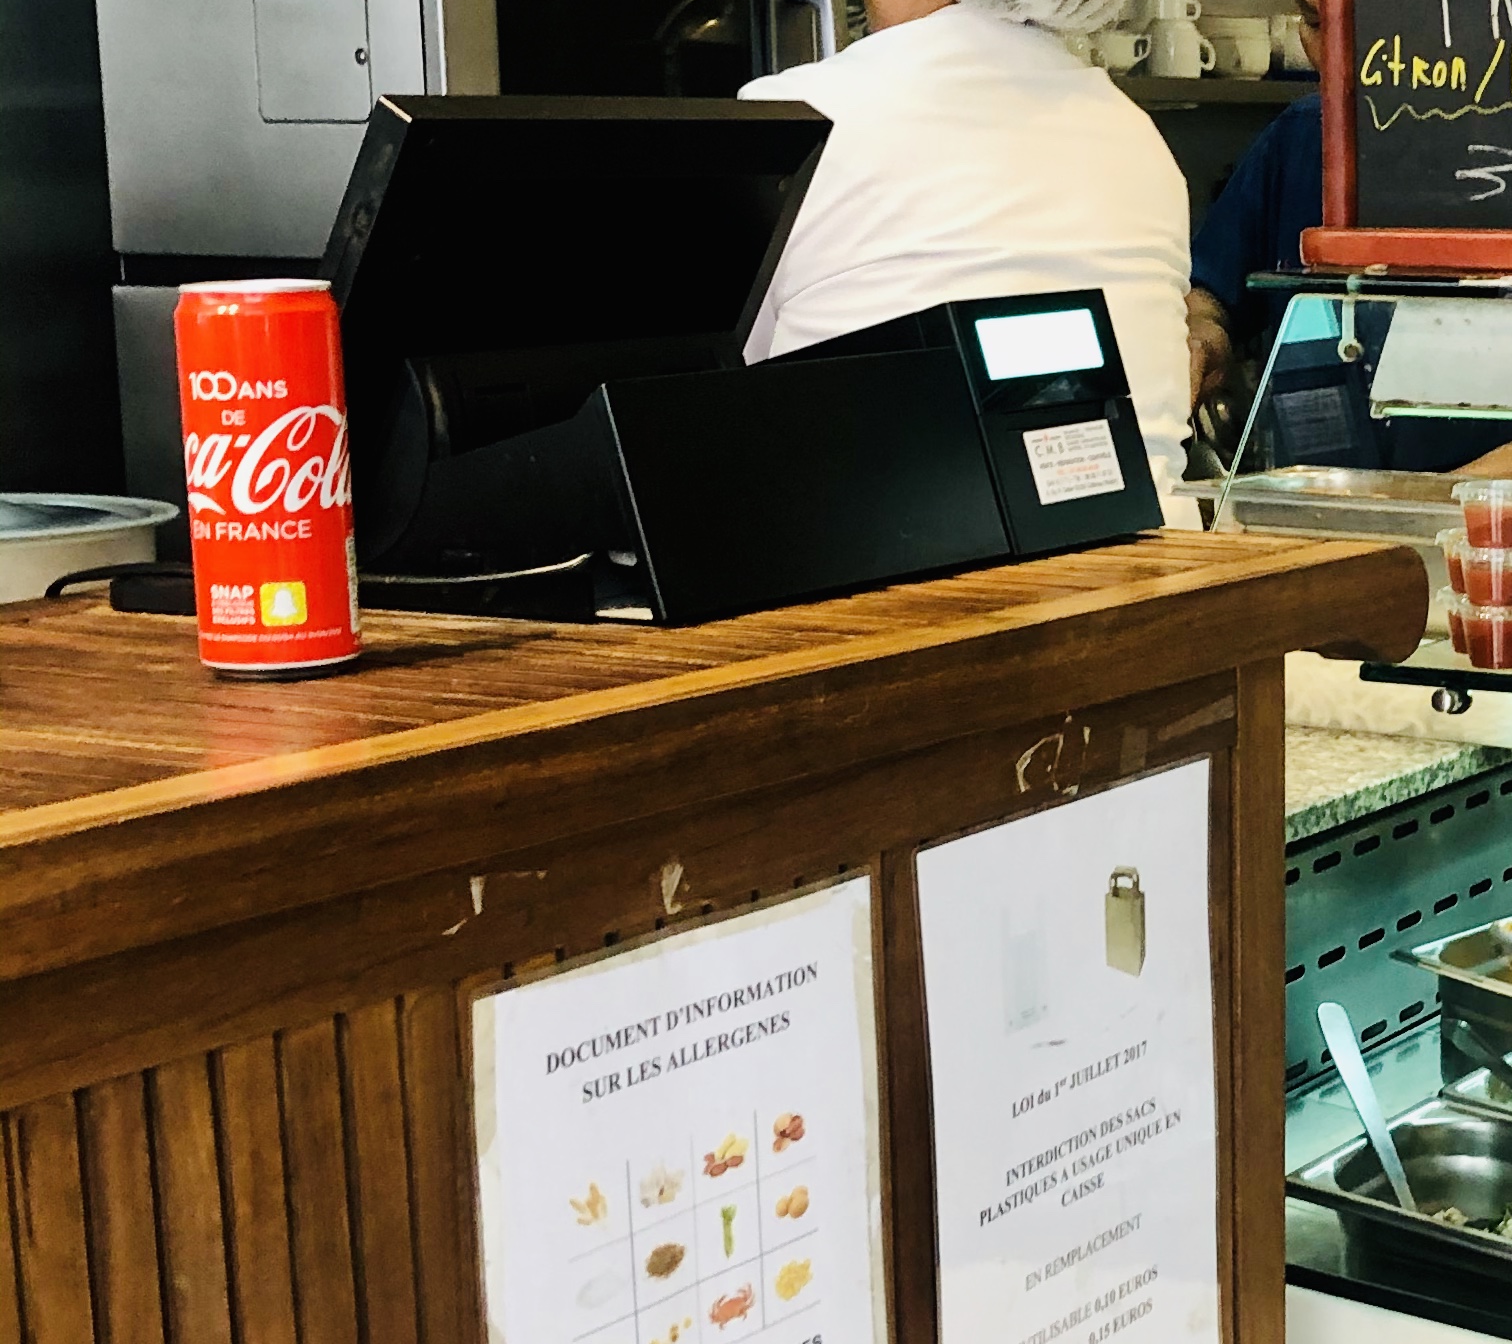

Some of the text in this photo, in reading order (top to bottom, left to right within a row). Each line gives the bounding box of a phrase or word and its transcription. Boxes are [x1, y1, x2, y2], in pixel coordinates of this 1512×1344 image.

[221, 410, 246, 426] DE
[215, 518, 313, 543] FRANCE
[545, 960, 820, 1076] DOCUMENT D'INFORMATION
[581, 1009, 792, 1105] SUR LES ALLERGENES
[1011, 1092, 1035, 1119] LOI
[1037, 1088, 1052, 1106] du
[1069, 1050, 1121, 1091] JUILLET
[1122, 1039, 1149, 1067] 2017
[979, 1108, 1182, 1228] PLASTIQUES A USAGE UNIQUE EN
[1005, 1096, 1157, 1188] INTERDICTION DES SACS
[1060, 1171, 1106, 1208] CAISSE
[1025, 1212, 1144, 1293] EN REMPLACEMENT
[1117, 1263, 1159, 1301] EUROS
[1112, 1297, 1154, 1334] EUROS
